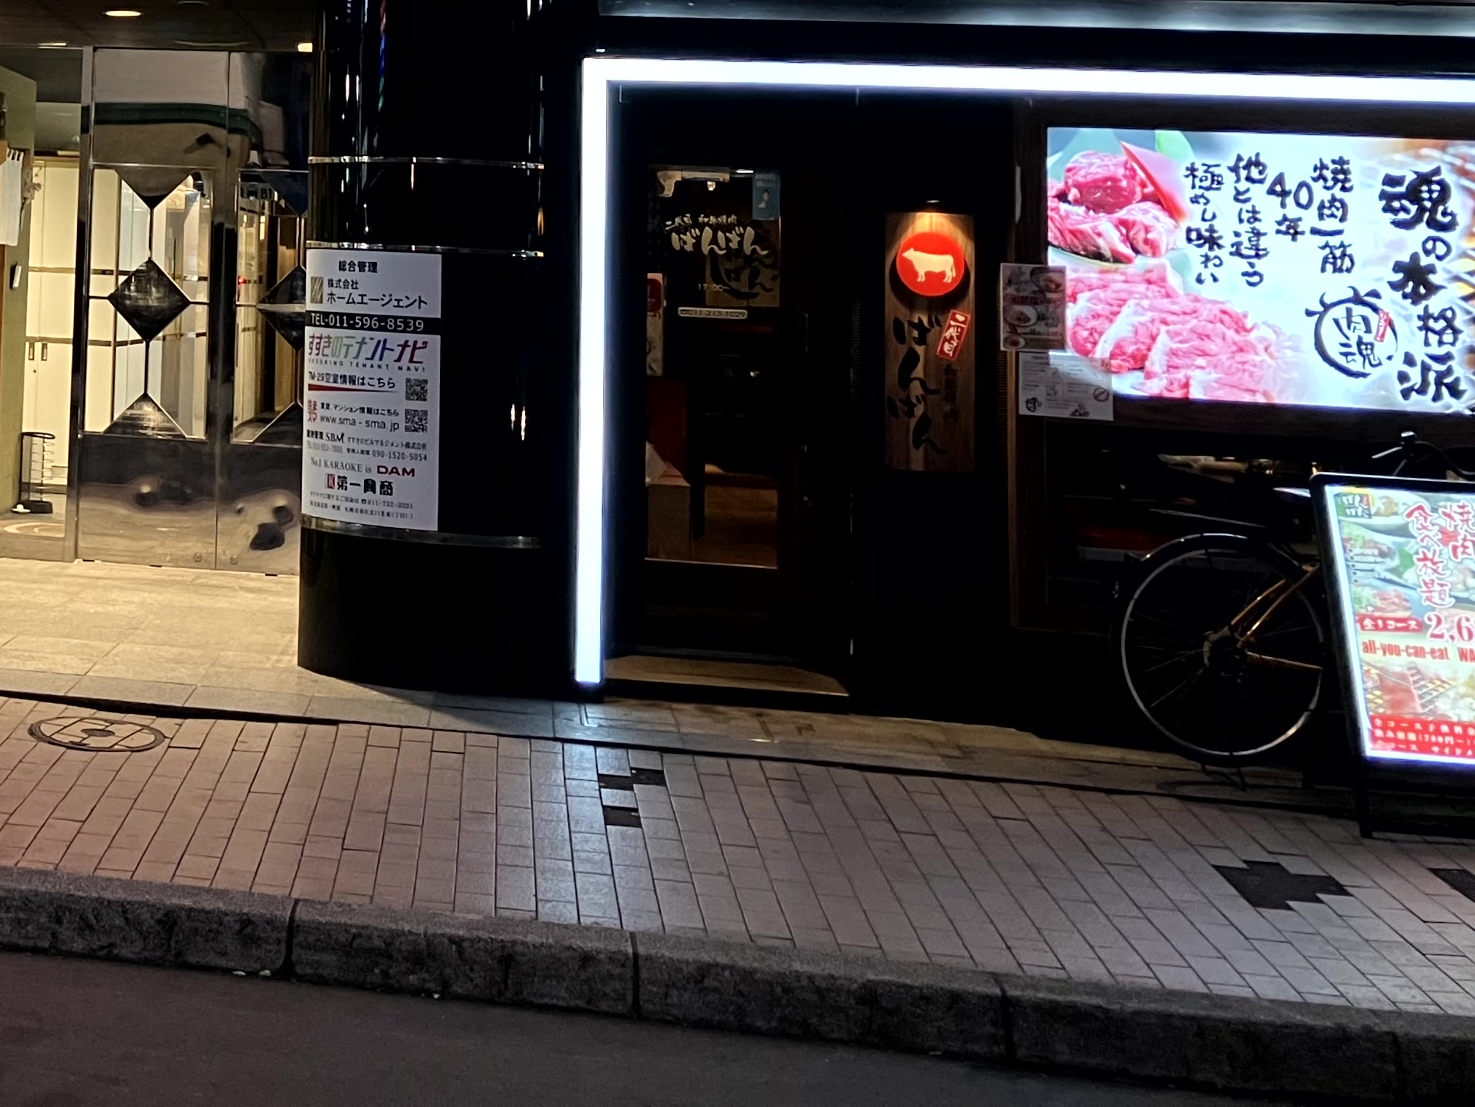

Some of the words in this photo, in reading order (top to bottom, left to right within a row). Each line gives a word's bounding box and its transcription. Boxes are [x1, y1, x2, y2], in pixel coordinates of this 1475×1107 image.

[671, 226, 769, 255] ばんばん
[338, 260, 378, 273] 総合管理
[328, 279, 359, 290] 株式会社
[1379, 166, 1466, 403] 魂の本格派
[327, 291, 428, 309] ホームエージェント
[324, 459, 363, 472] KARAOKE
[377, 465, 415, 477] DAM
[1405, 504, 1451, 607] 食べ放題
[1362, 640, 1450, 661] all-you-can-eat
